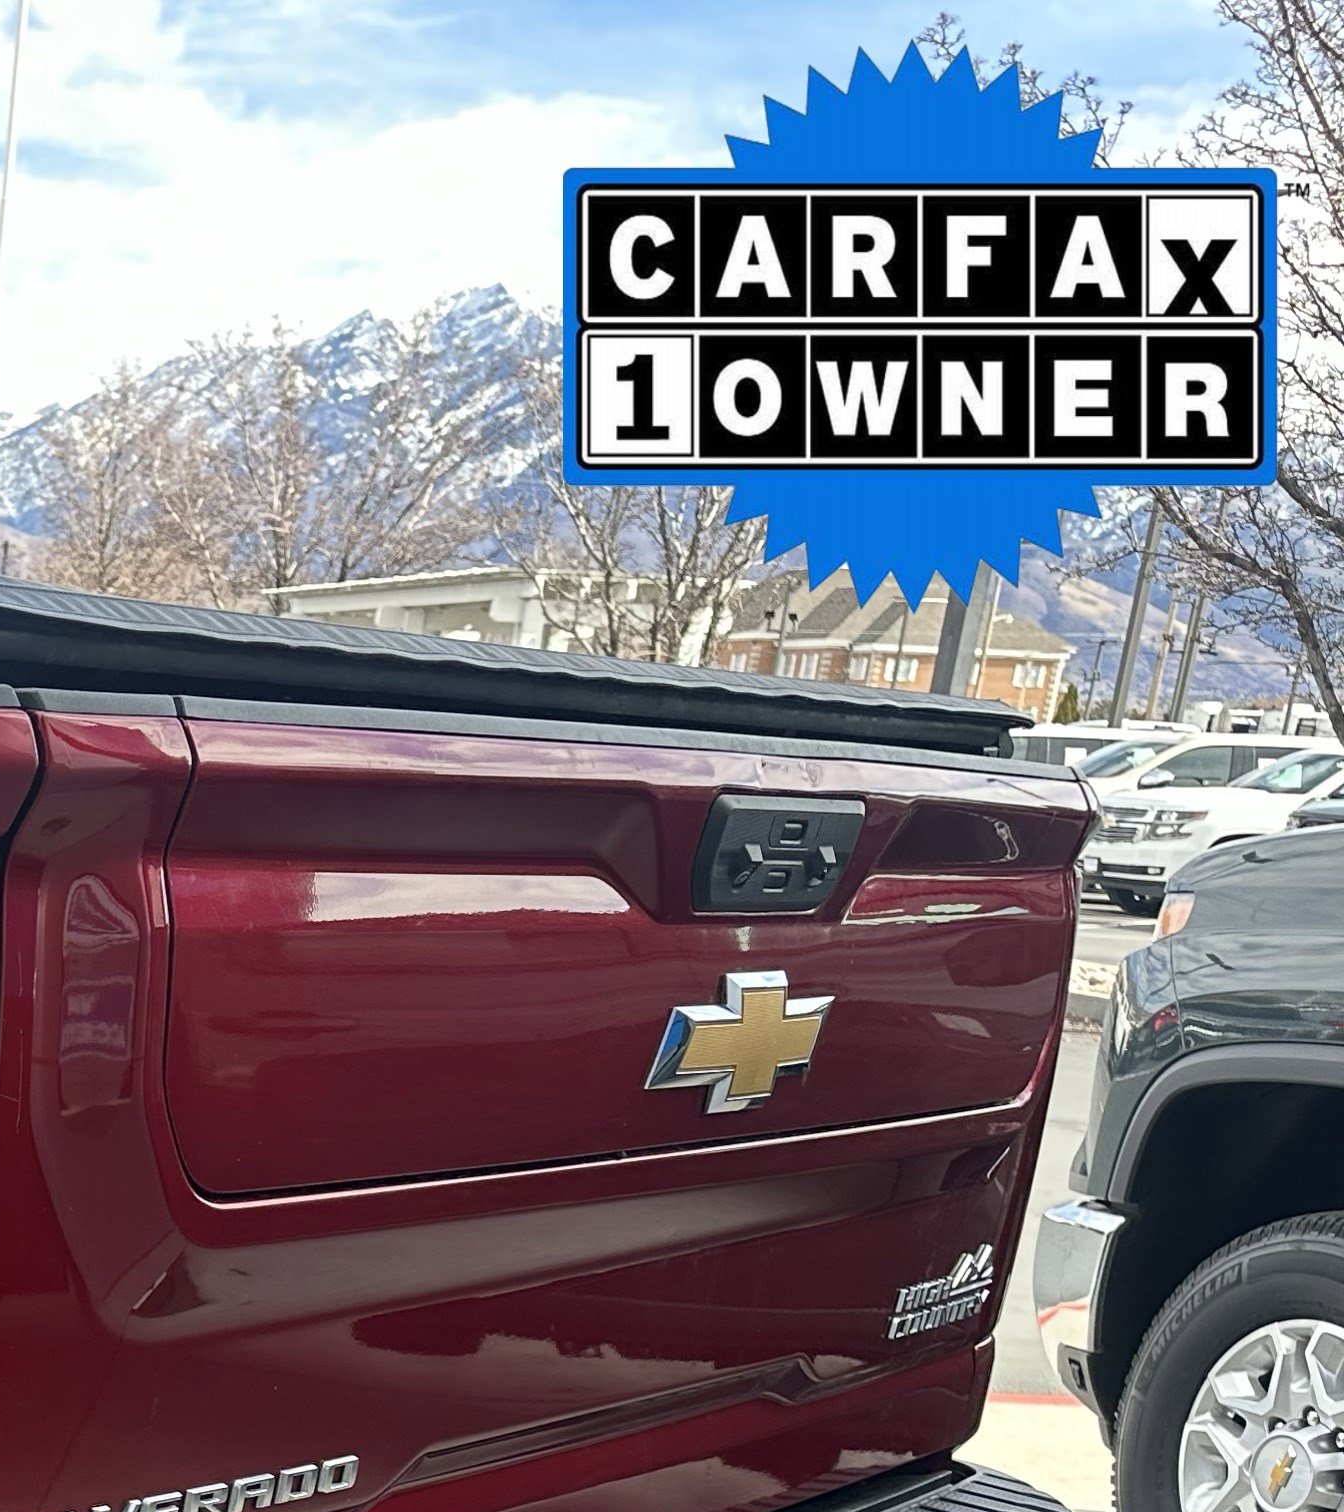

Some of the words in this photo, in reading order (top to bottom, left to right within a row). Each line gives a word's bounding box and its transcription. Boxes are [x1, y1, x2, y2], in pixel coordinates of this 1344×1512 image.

[887, 1289, 990, 1340] COUNTRY
[895, 1275, 953, 1314] HIGH
[1151, 1263, 1241, 1361] MICHELIN
